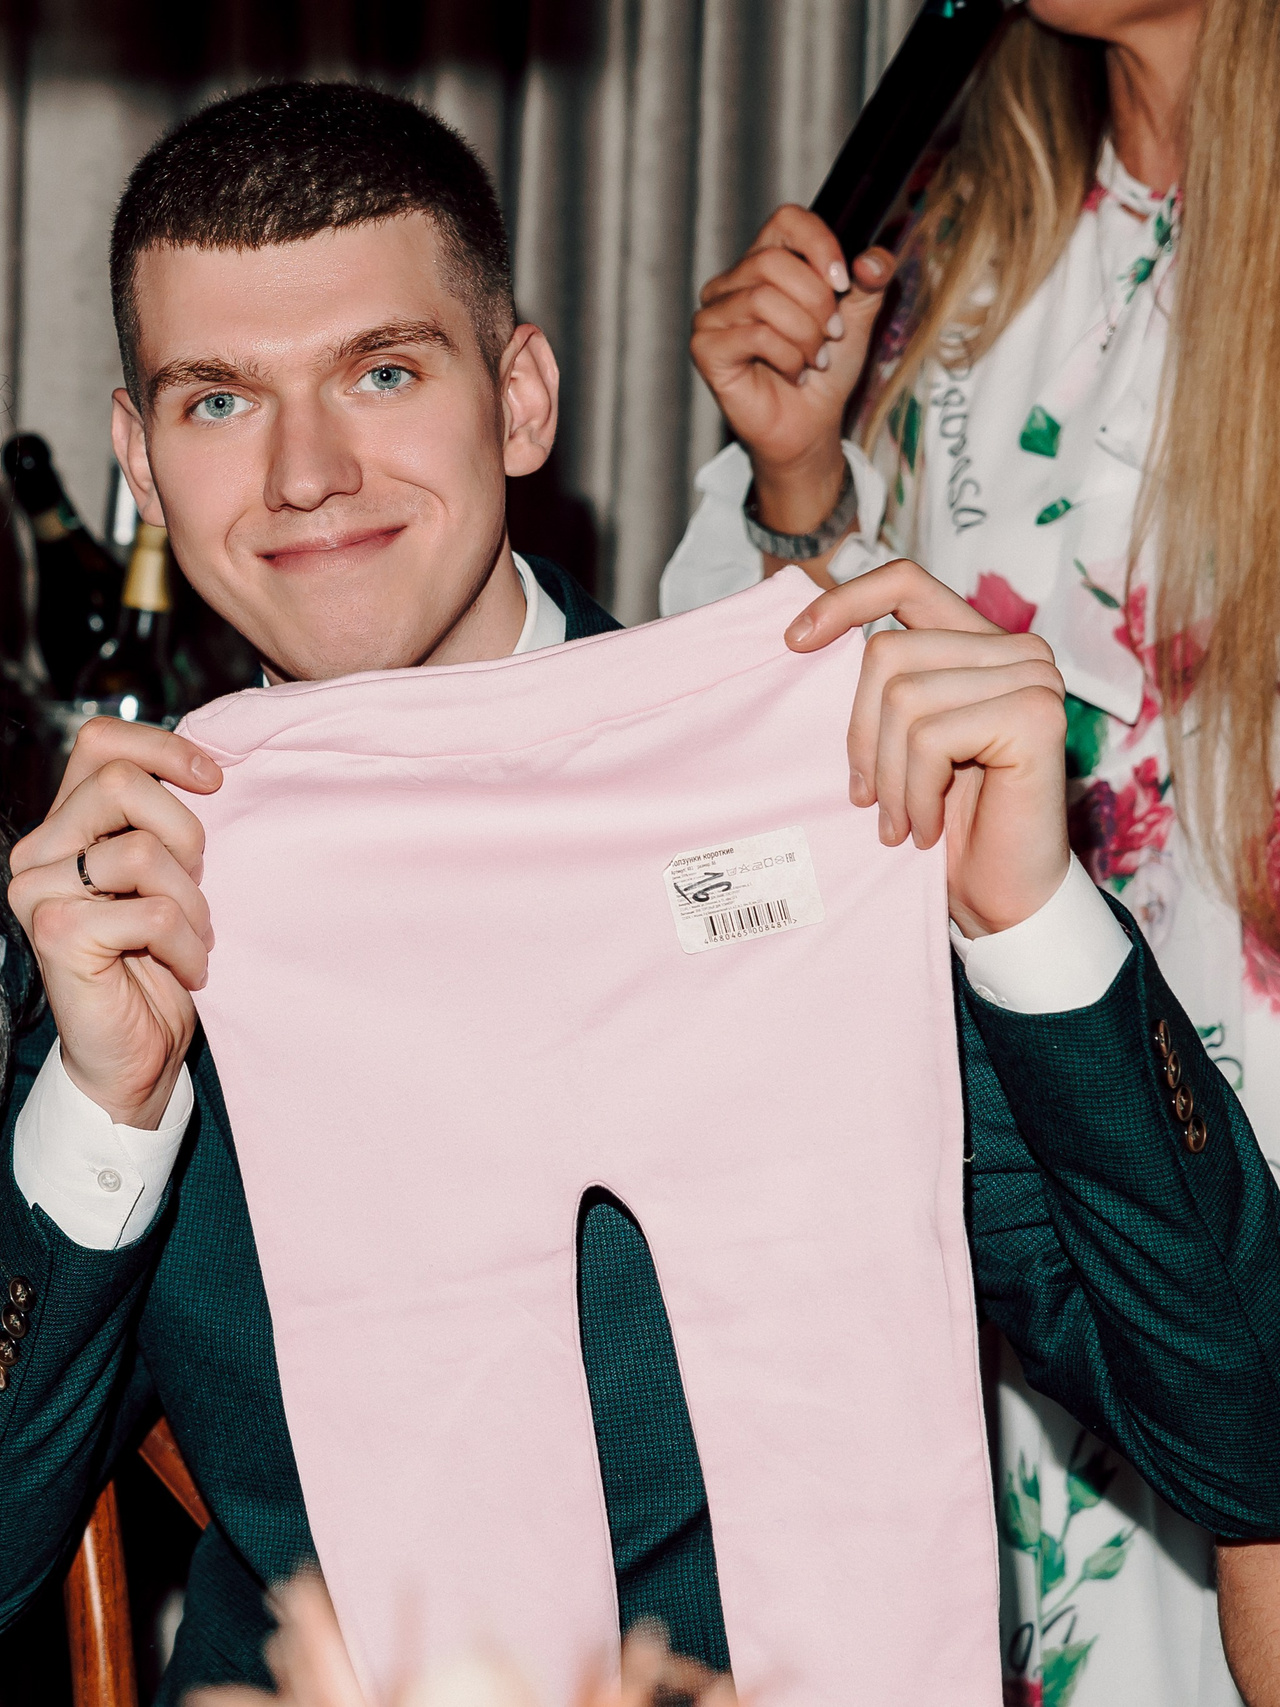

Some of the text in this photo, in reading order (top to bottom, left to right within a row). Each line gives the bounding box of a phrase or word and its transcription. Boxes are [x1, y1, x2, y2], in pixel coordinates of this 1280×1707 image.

[702, 847, 735, 861] короткие
[713, 929, 749, 943] 680465
[752, 920, 788, 935] 008481
